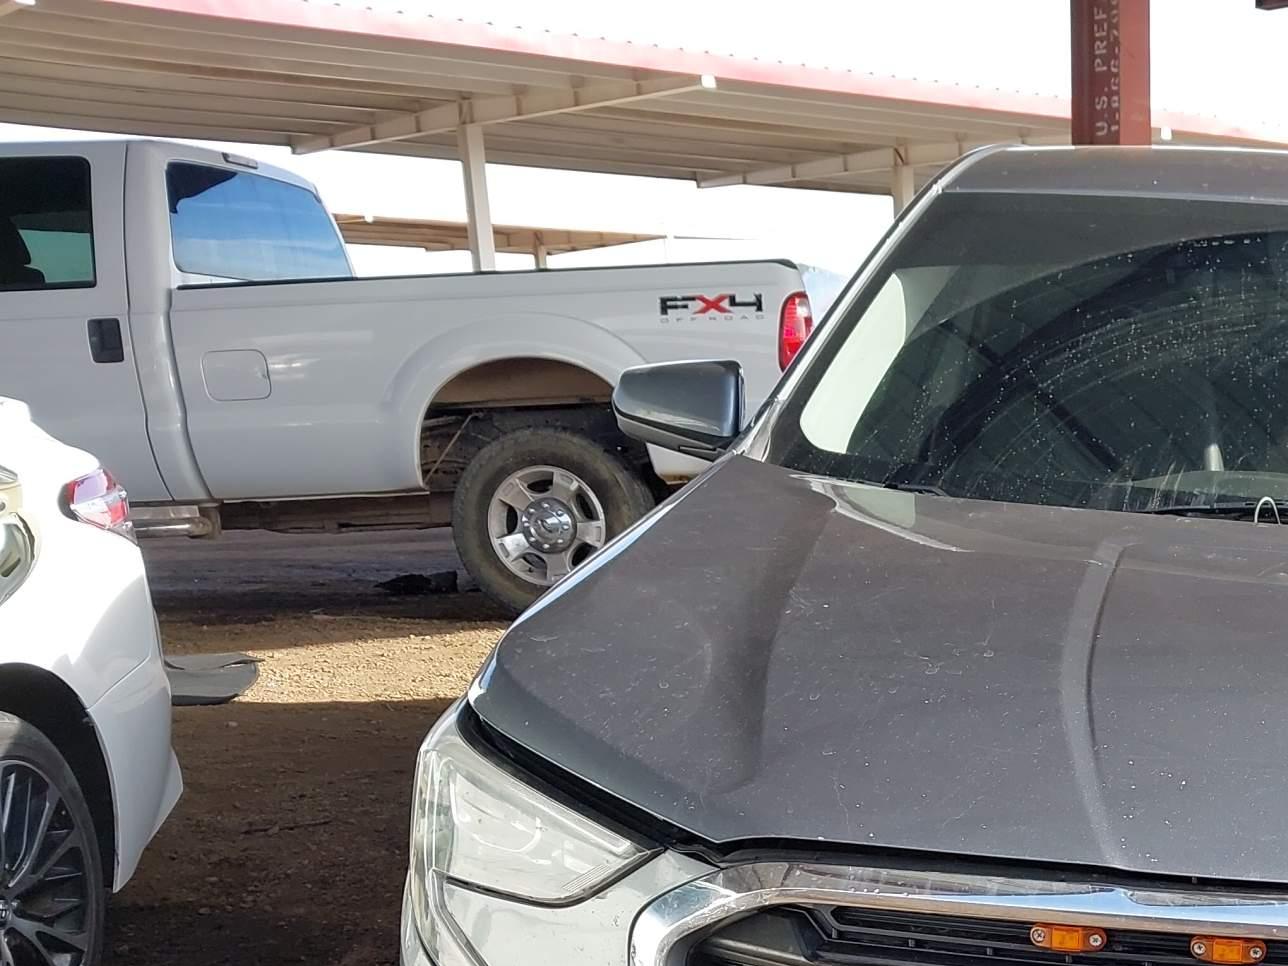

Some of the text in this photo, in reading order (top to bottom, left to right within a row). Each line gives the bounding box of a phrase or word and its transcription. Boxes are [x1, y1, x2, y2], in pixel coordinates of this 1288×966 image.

[1093, 0, 1109, 136] U.S. PREF
[659, 293, 763, 315] FX4
